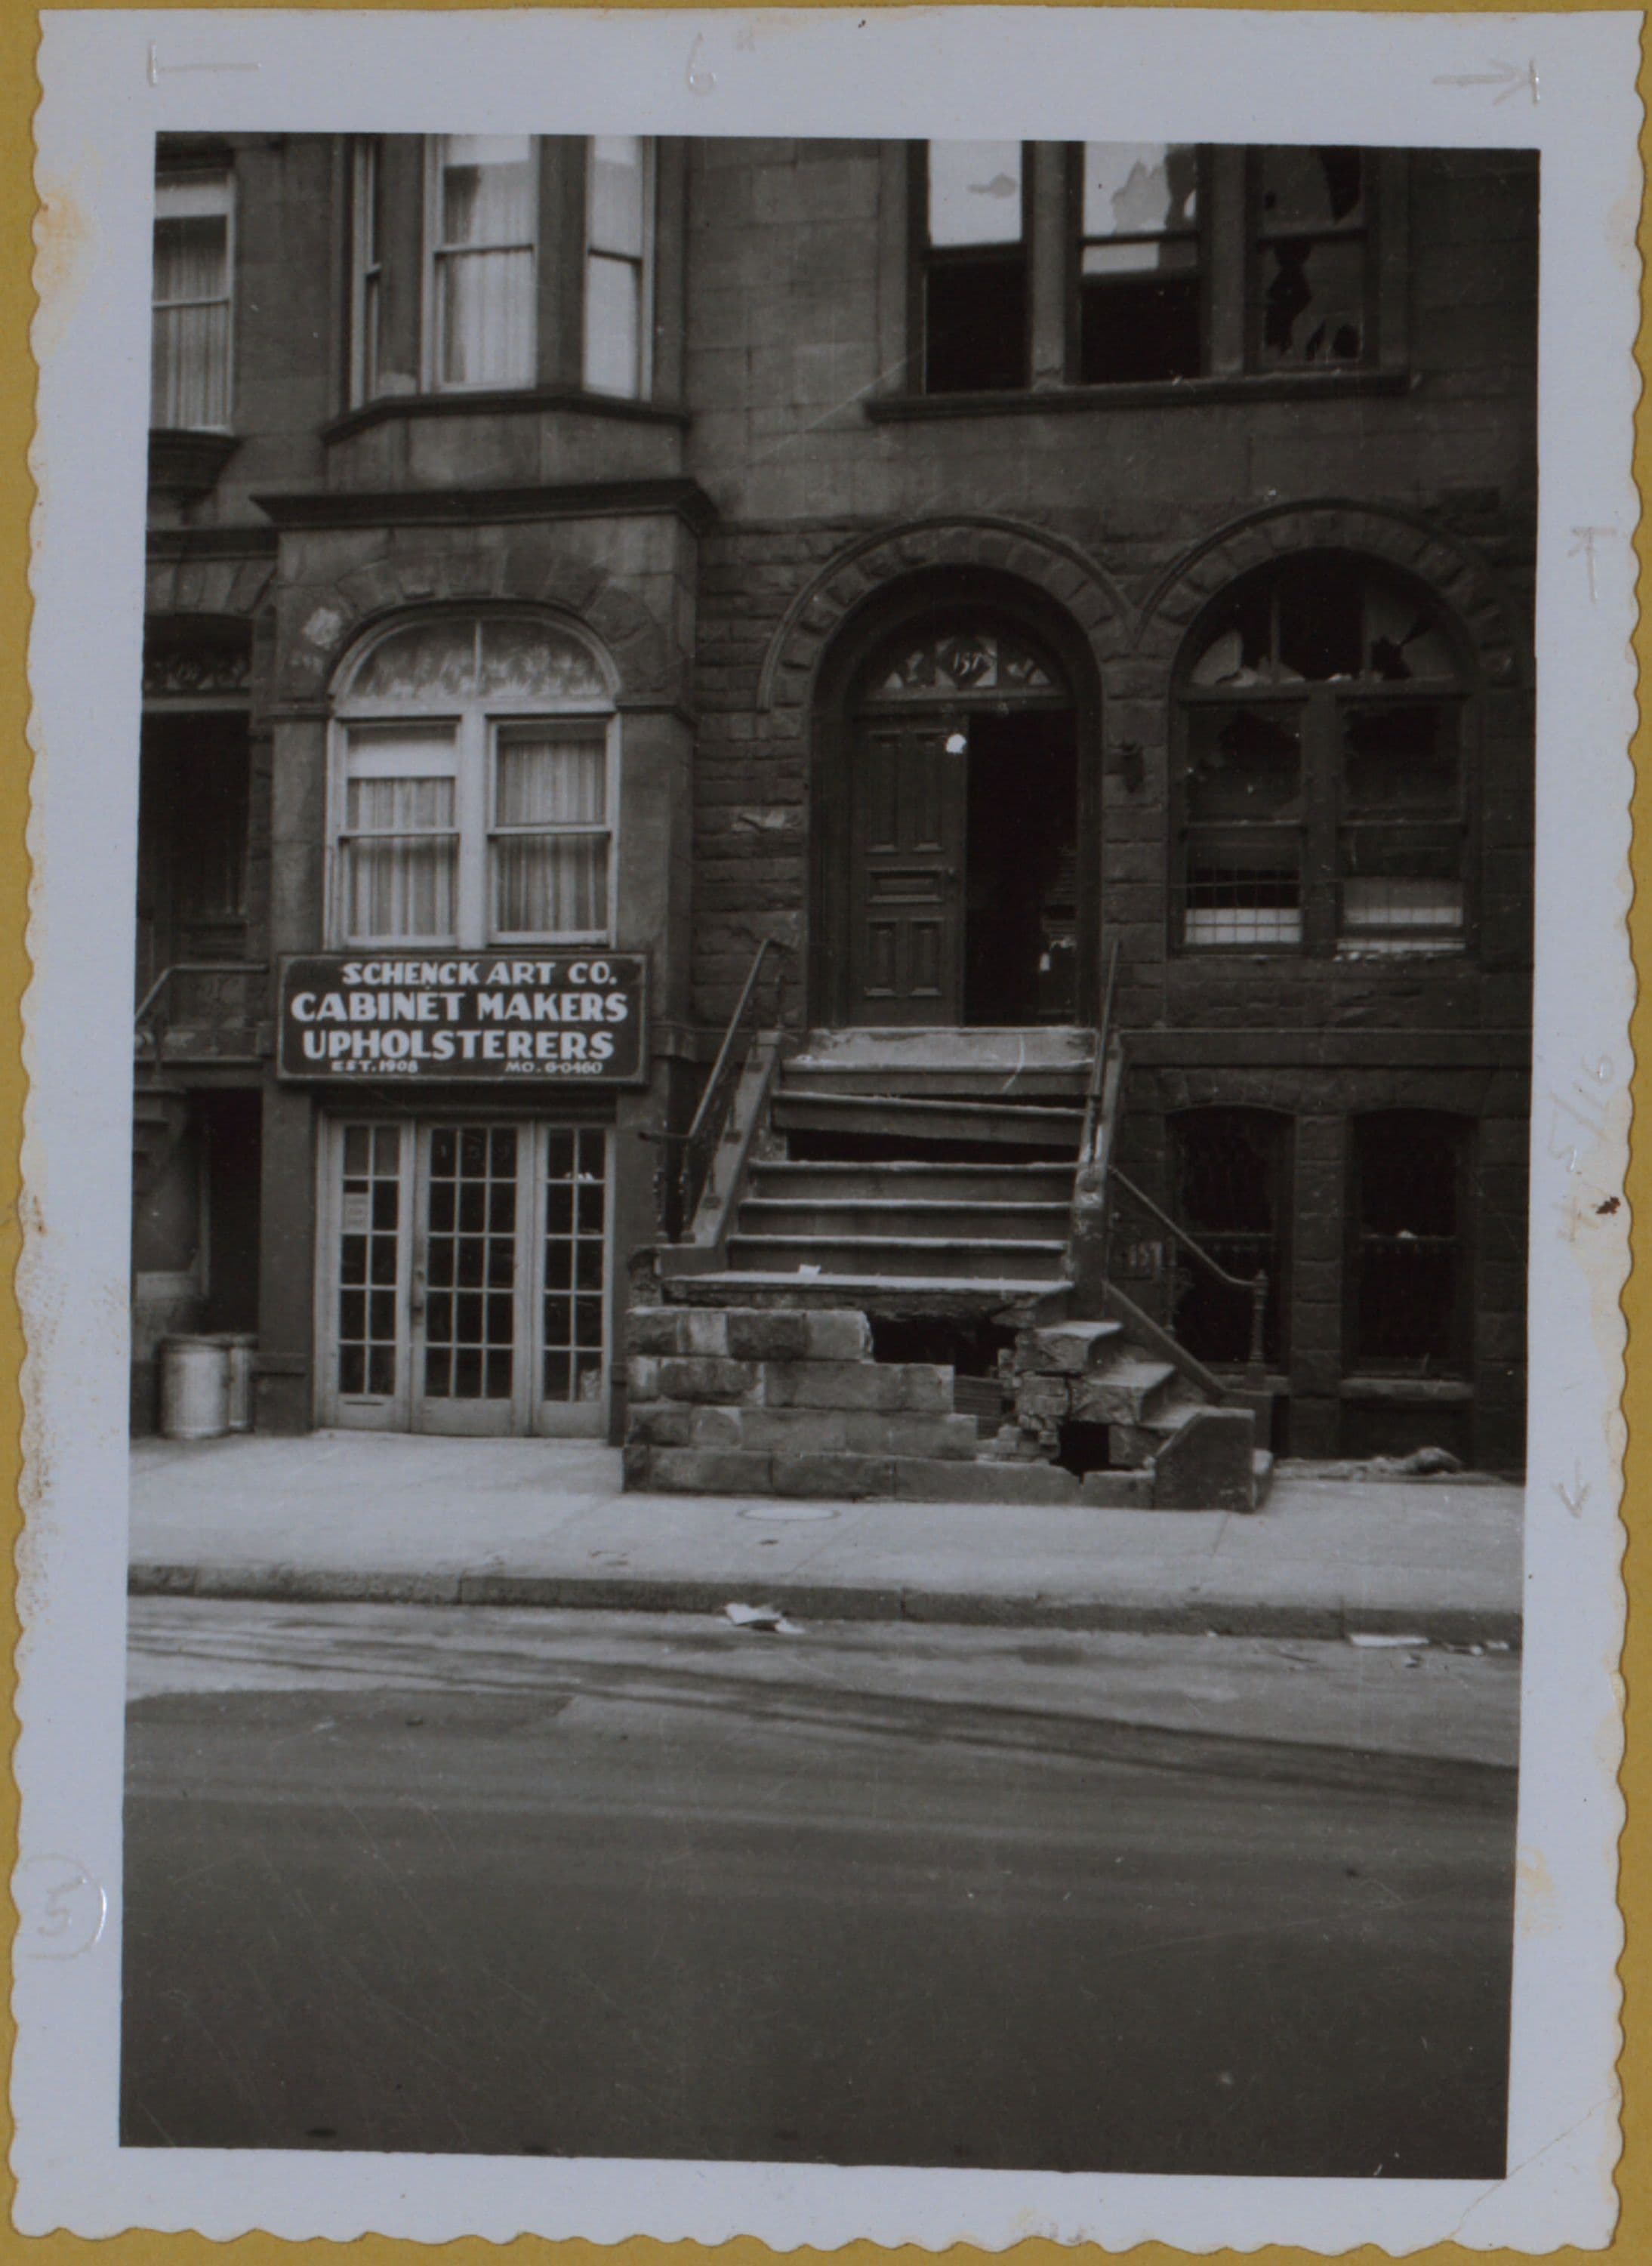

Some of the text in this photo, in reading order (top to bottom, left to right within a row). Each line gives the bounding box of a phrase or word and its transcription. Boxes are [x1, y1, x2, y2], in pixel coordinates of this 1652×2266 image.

[342, 960, 617, 985] SCHENCK ART CO.
[291, 991, 627, 1022] CABINET MAKERS
[304, 1029, 614, 1059] UPHOLSTERERS
[331, 1059, 377, 1074] EST.
[504, 1060, 541, 1074] MO.
